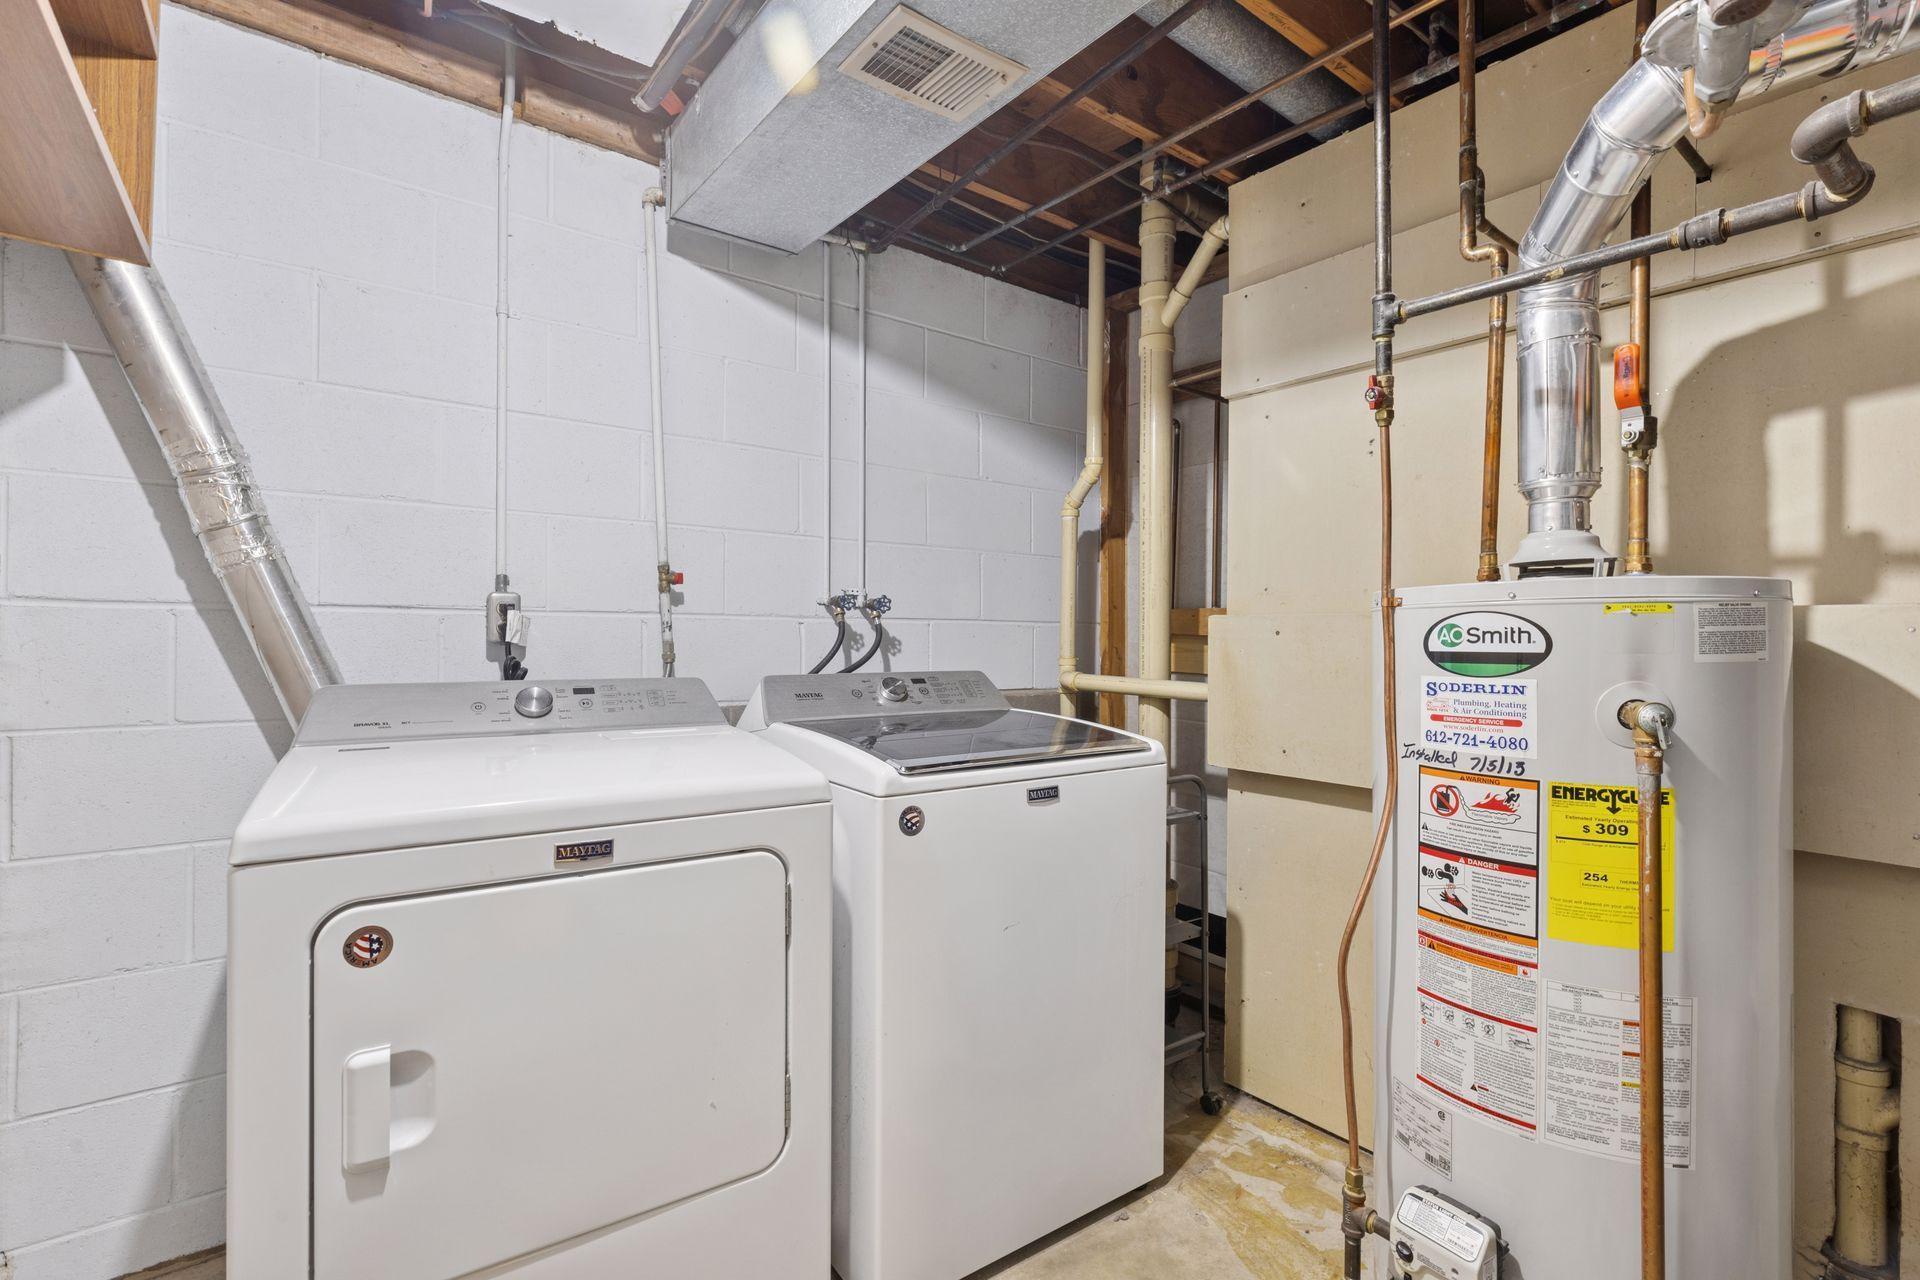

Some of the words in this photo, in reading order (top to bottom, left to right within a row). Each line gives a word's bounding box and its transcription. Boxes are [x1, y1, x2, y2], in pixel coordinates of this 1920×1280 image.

[1466, 626, 1532, 645] Smith
[1426, 681, 1527, 697] SODERLIN
[1453, 698, 1492, 708] Plumbing,
[1494, 700, 1527, 711] Heating
[1461, 707, 1472, 715] Air
[1473, 708, 1527, 720] Conditioning
[1443, 716, 1477, 724] EMERGENCY
[1478, 718, 1505, 726] SERVICE
[1443, 724, 1504, 734] www.soderlin.com
[1425, 729, 1529, 751] 612-721-4080
[1401, 742, 1458, 768] Installed
[1470, 755, 1526, 777] 7/5/13
[1465, 775, 1501, 786] WARNING
[1029, 789, 1058, 799] MAYTAG
[1565, 814, 1593, 822] Estimated
[1582, 824, 1591, 834] $
[1595, 823, 1629, 837] 309
[558, 843, 611, 858] MAYTAG
[1467, 858, 1500, 871] DANGER
[1584, 872, 1609, 883] 254
